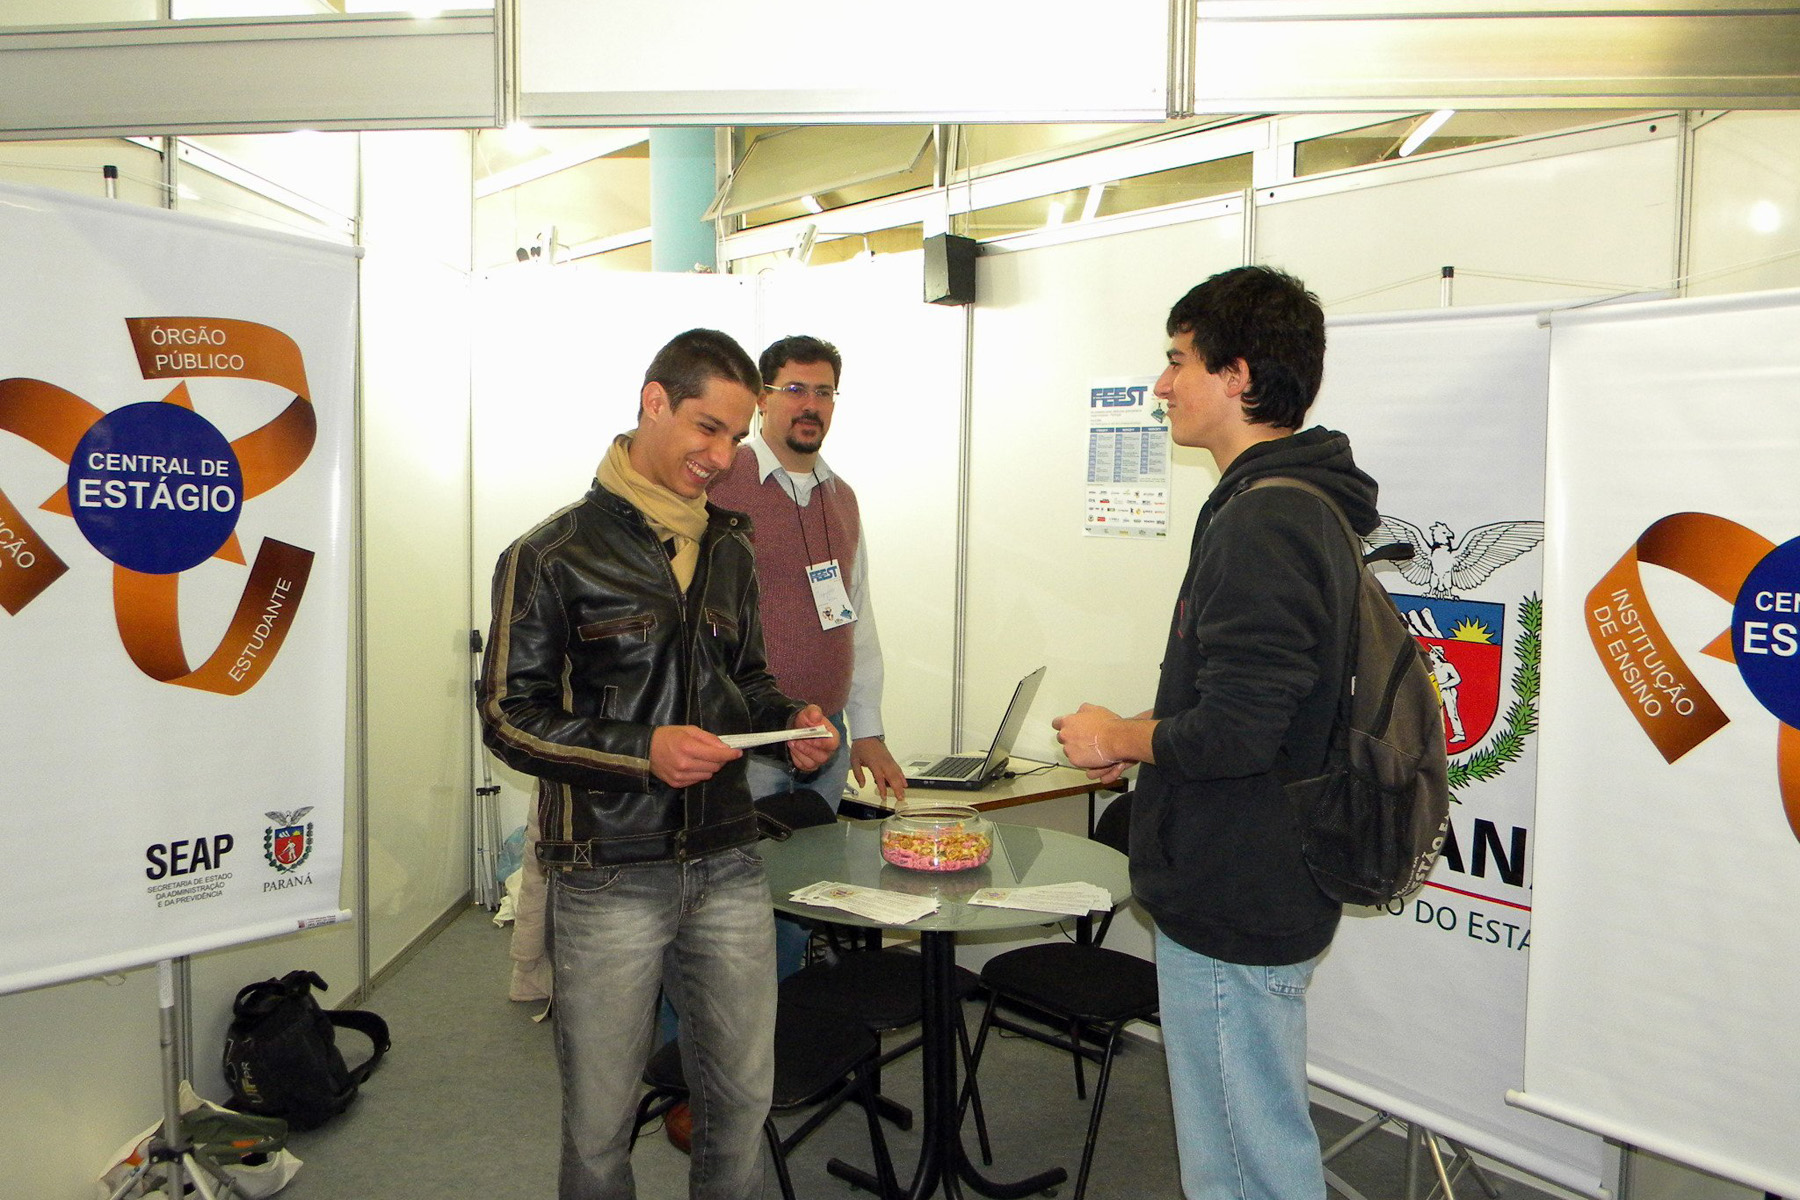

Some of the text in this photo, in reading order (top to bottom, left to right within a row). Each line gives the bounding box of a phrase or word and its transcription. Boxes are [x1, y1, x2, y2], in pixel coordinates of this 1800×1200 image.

[151, 325, 226, 346] ÓRGÃO
[155, 350, 244, 371] PÚBLICO
[1091, 386, 1148, 408] FEEST
[88, 452, 230, 478] CENTRAL DE
[78, 476, 236, 513] ESTÁGIO
[809, 566, 837, 583] FEEST
[228, 577, 292, 683] ESTUDANTE
[1594, 605, 1662, 718] DE ENSINO
[1611, 588, 1694, 716] INSTITUIÇÃO
[146, 833, 234, 880] SEAP
[147, 872, 233, 893] SECRETARIA DE ESTADO
[167, 881, 225, 899] ADMINISTRAÇÃO
[263, 872, 313, 892] PARANÁ
[164, 899, 175, 907] DA
[175, 890, 223, 904] PREVIDÊNCIA
[1415, 899, 1457, 931] DO
